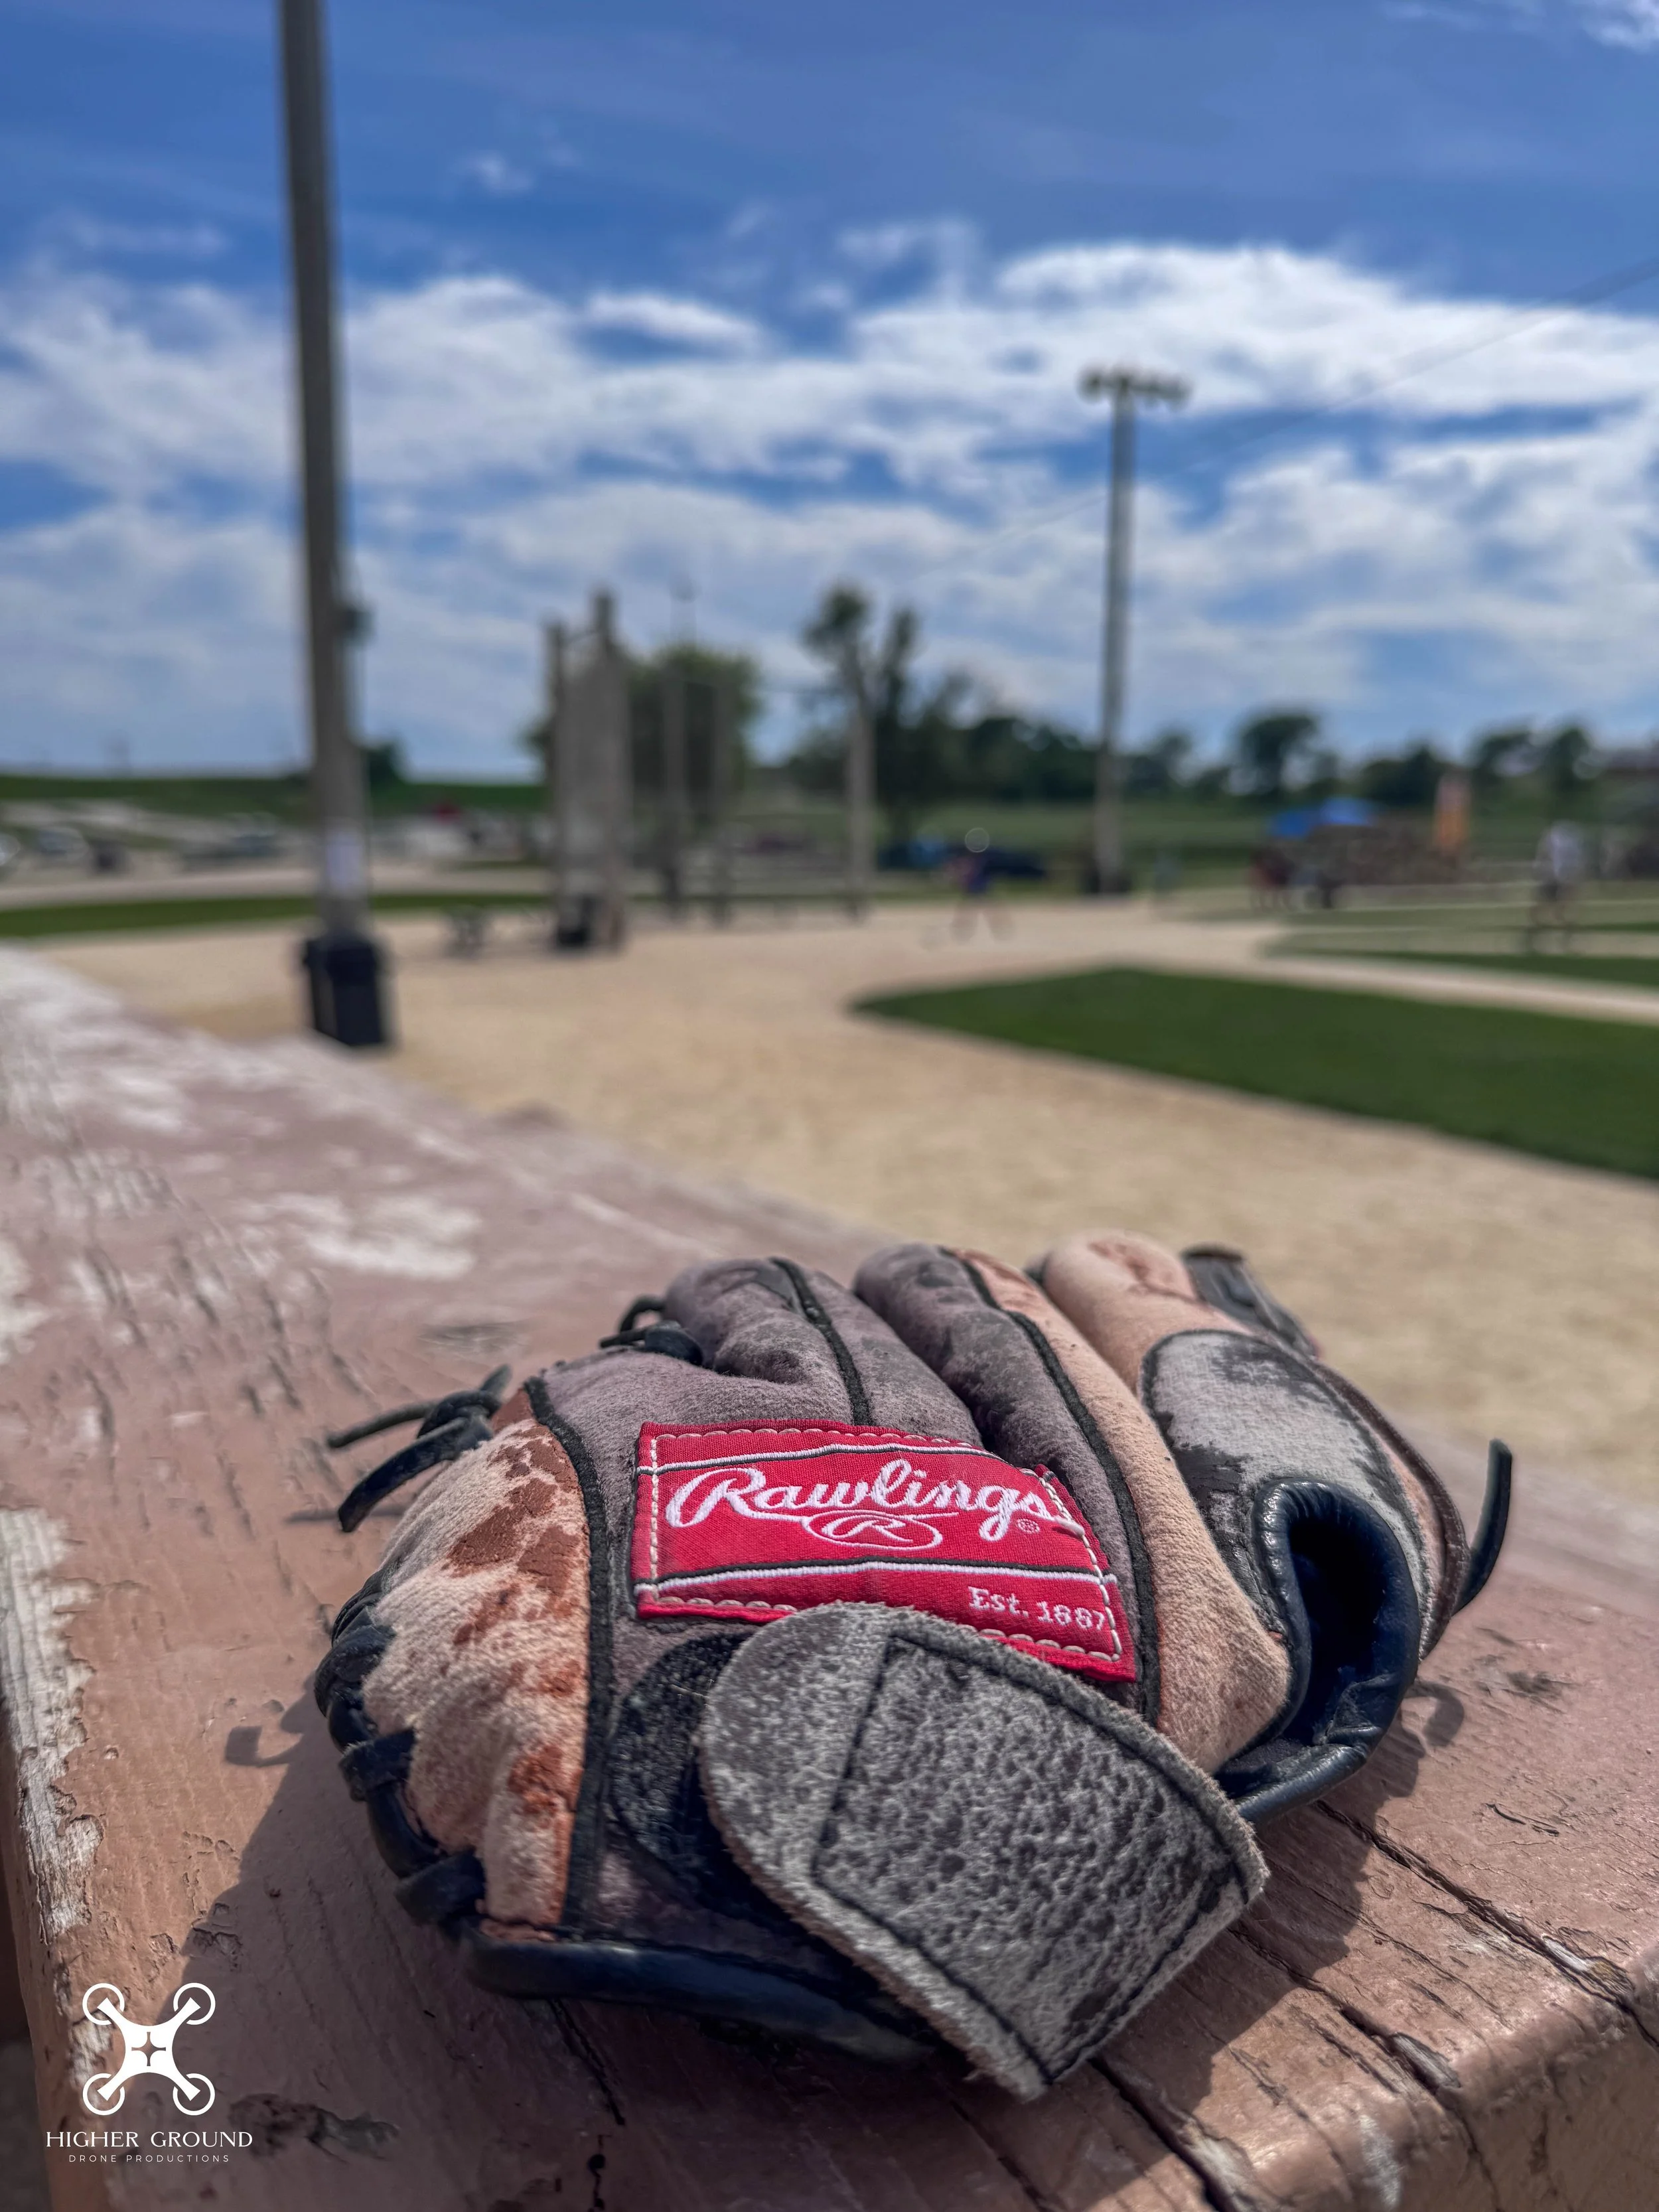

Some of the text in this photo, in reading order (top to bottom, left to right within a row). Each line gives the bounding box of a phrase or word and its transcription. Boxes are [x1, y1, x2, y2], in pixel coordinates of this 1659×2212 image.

[665, 1458, 1058, 1542] Rawlings
[968, 1585, 1106, 1631] Est. 1887
